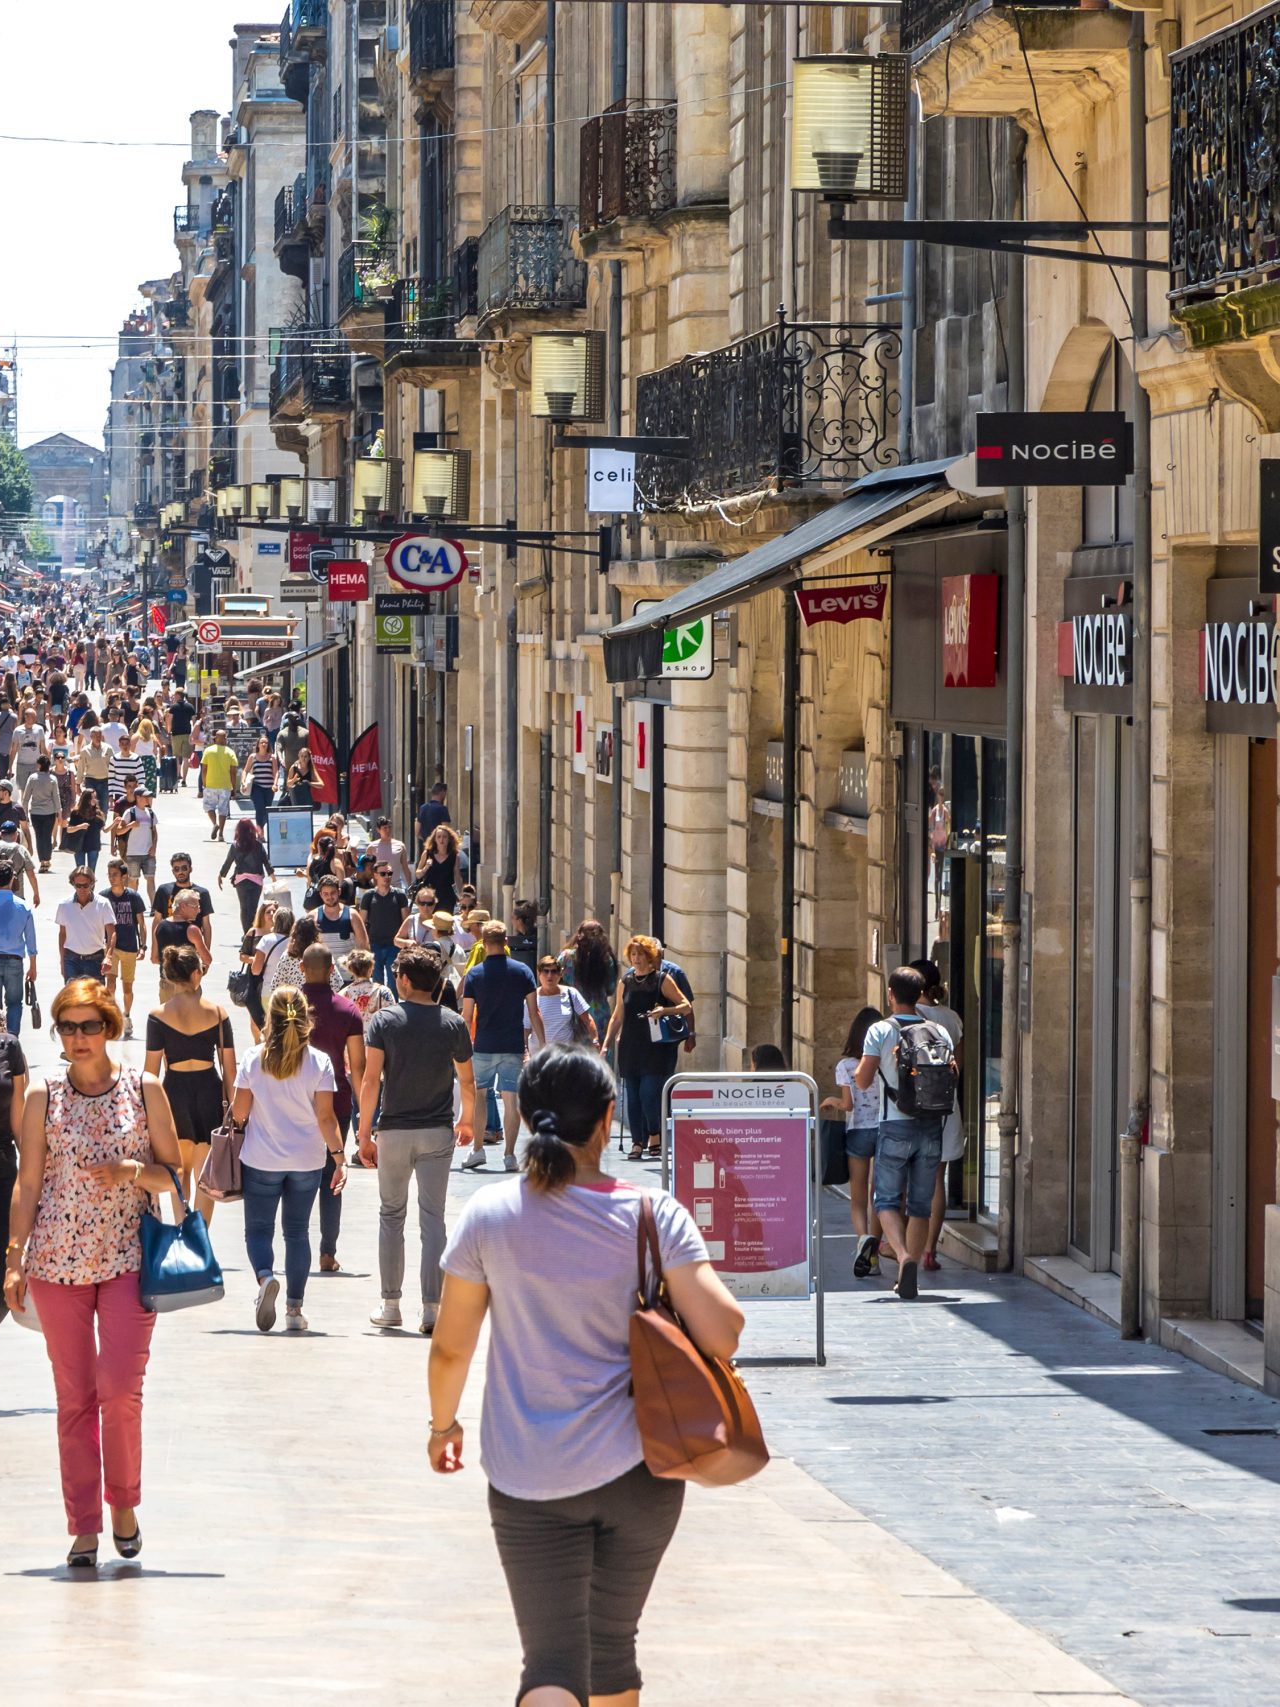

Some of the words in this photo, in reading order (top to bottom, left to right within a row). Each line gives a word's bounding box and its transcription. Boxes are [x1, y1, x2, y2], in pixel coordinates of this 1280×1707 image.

[400, 544, 454, 575] C&A
[211, 566, 231, 575] VANS
[330, 574, 367, 585] HEMA
[725, 1127, 744, 1135] bien
[745, 1127, 762, 1136] plus
[734, 1135, 782, 1145] parfumerie
